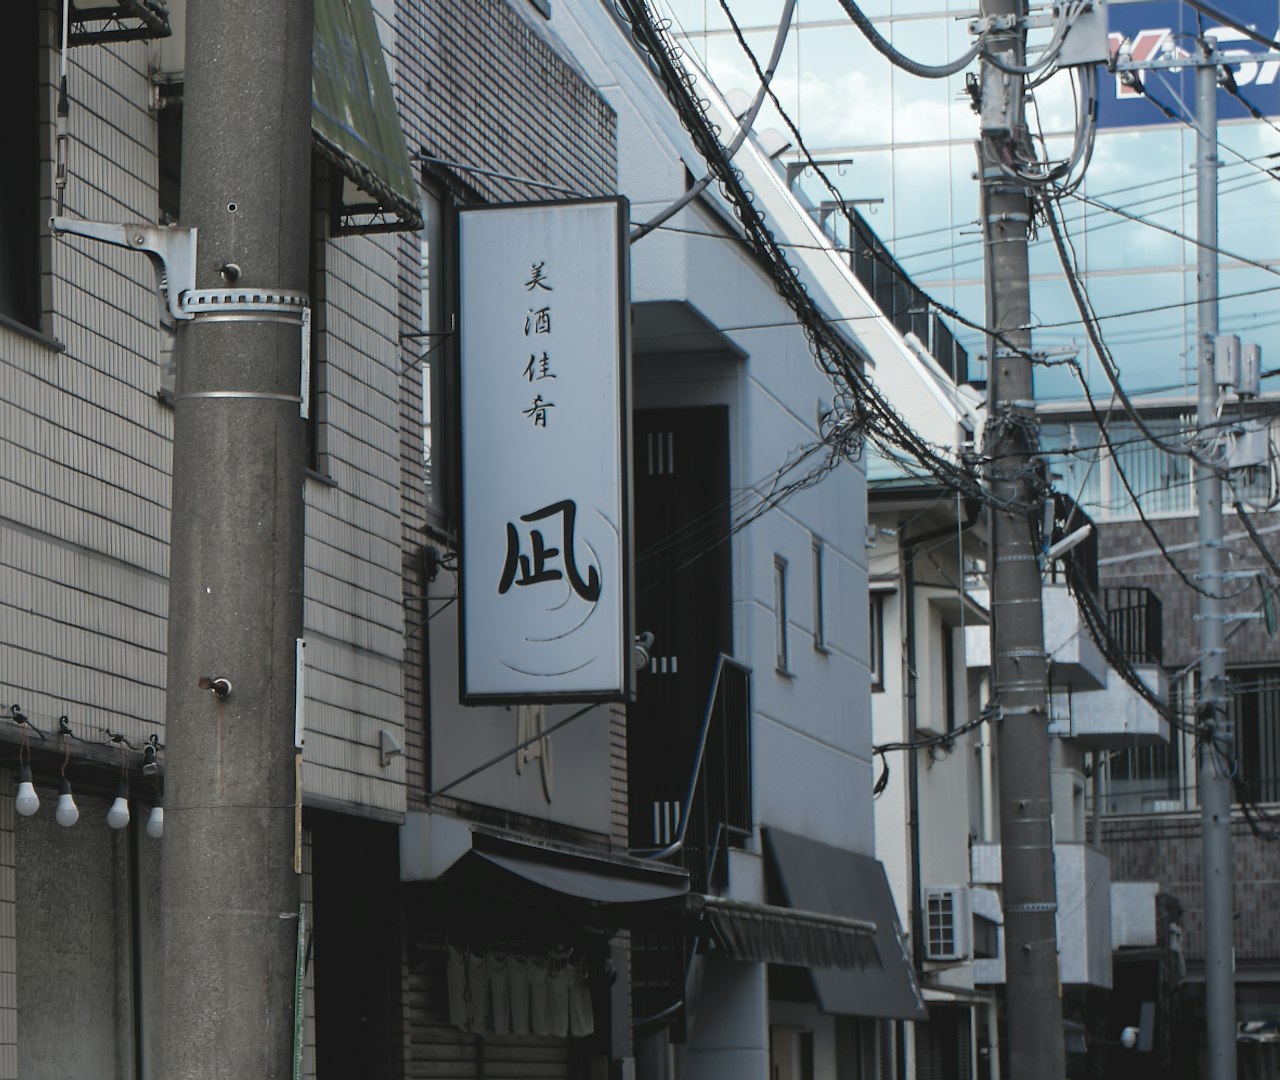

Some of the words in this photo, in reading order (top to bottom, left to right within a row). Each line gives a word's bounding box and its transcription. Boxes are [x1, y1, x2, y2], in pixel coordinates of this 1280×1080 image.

[521, 260, 557, 428] 美酒佳肴
[497, 499, 600, 602] 凪
